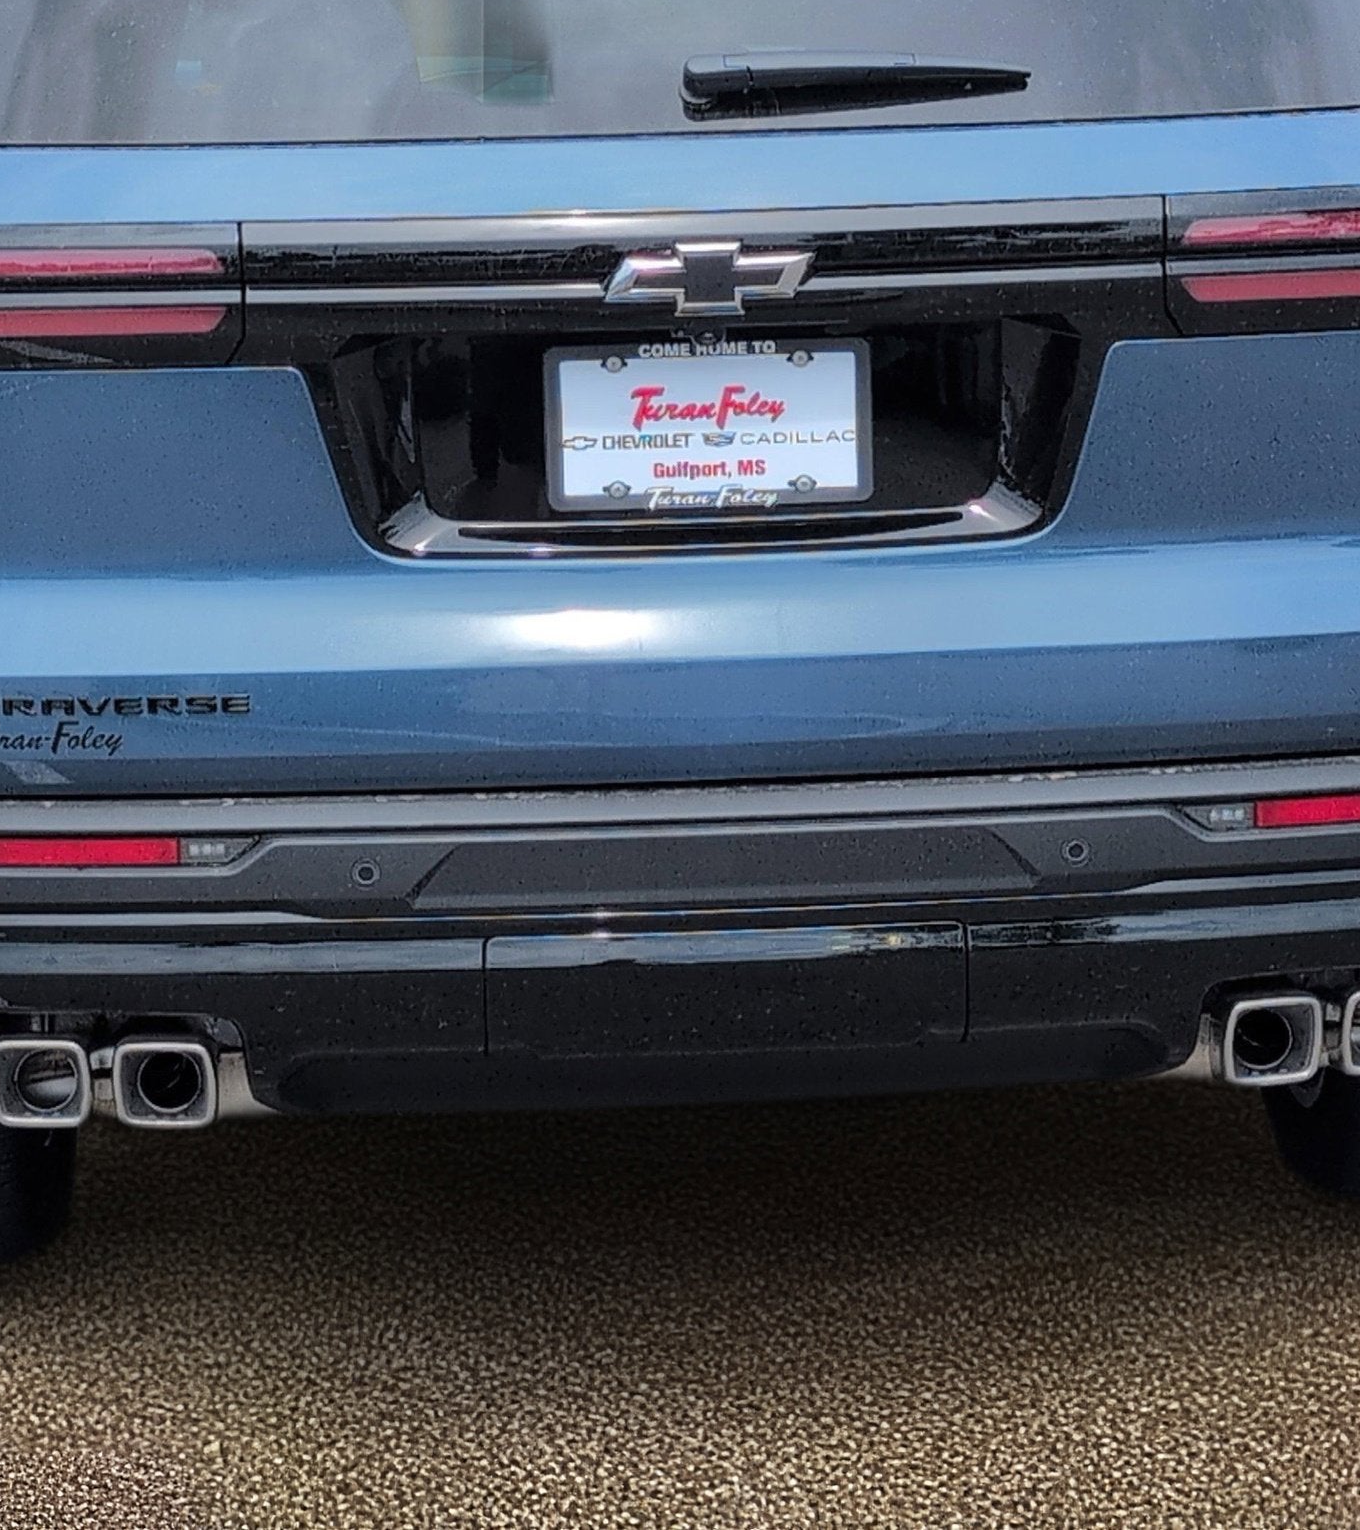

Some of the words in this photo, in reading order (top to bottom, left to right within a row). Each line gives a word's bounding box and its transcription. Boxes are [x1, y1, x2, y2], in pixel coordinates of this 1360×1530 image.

[638, 343, 691, 358] COME
[751, 340, 777, 354] TO
[631, 386, 716, 431] Turan
[716, 385, 785, 430] Foley
[602, 433, 692, 451] CHEVROLET
[739, 430, 856, 446] CADILLAC
[653, 461, 732, 480] Gulfport,
[737, 459, 766, 476] MS
